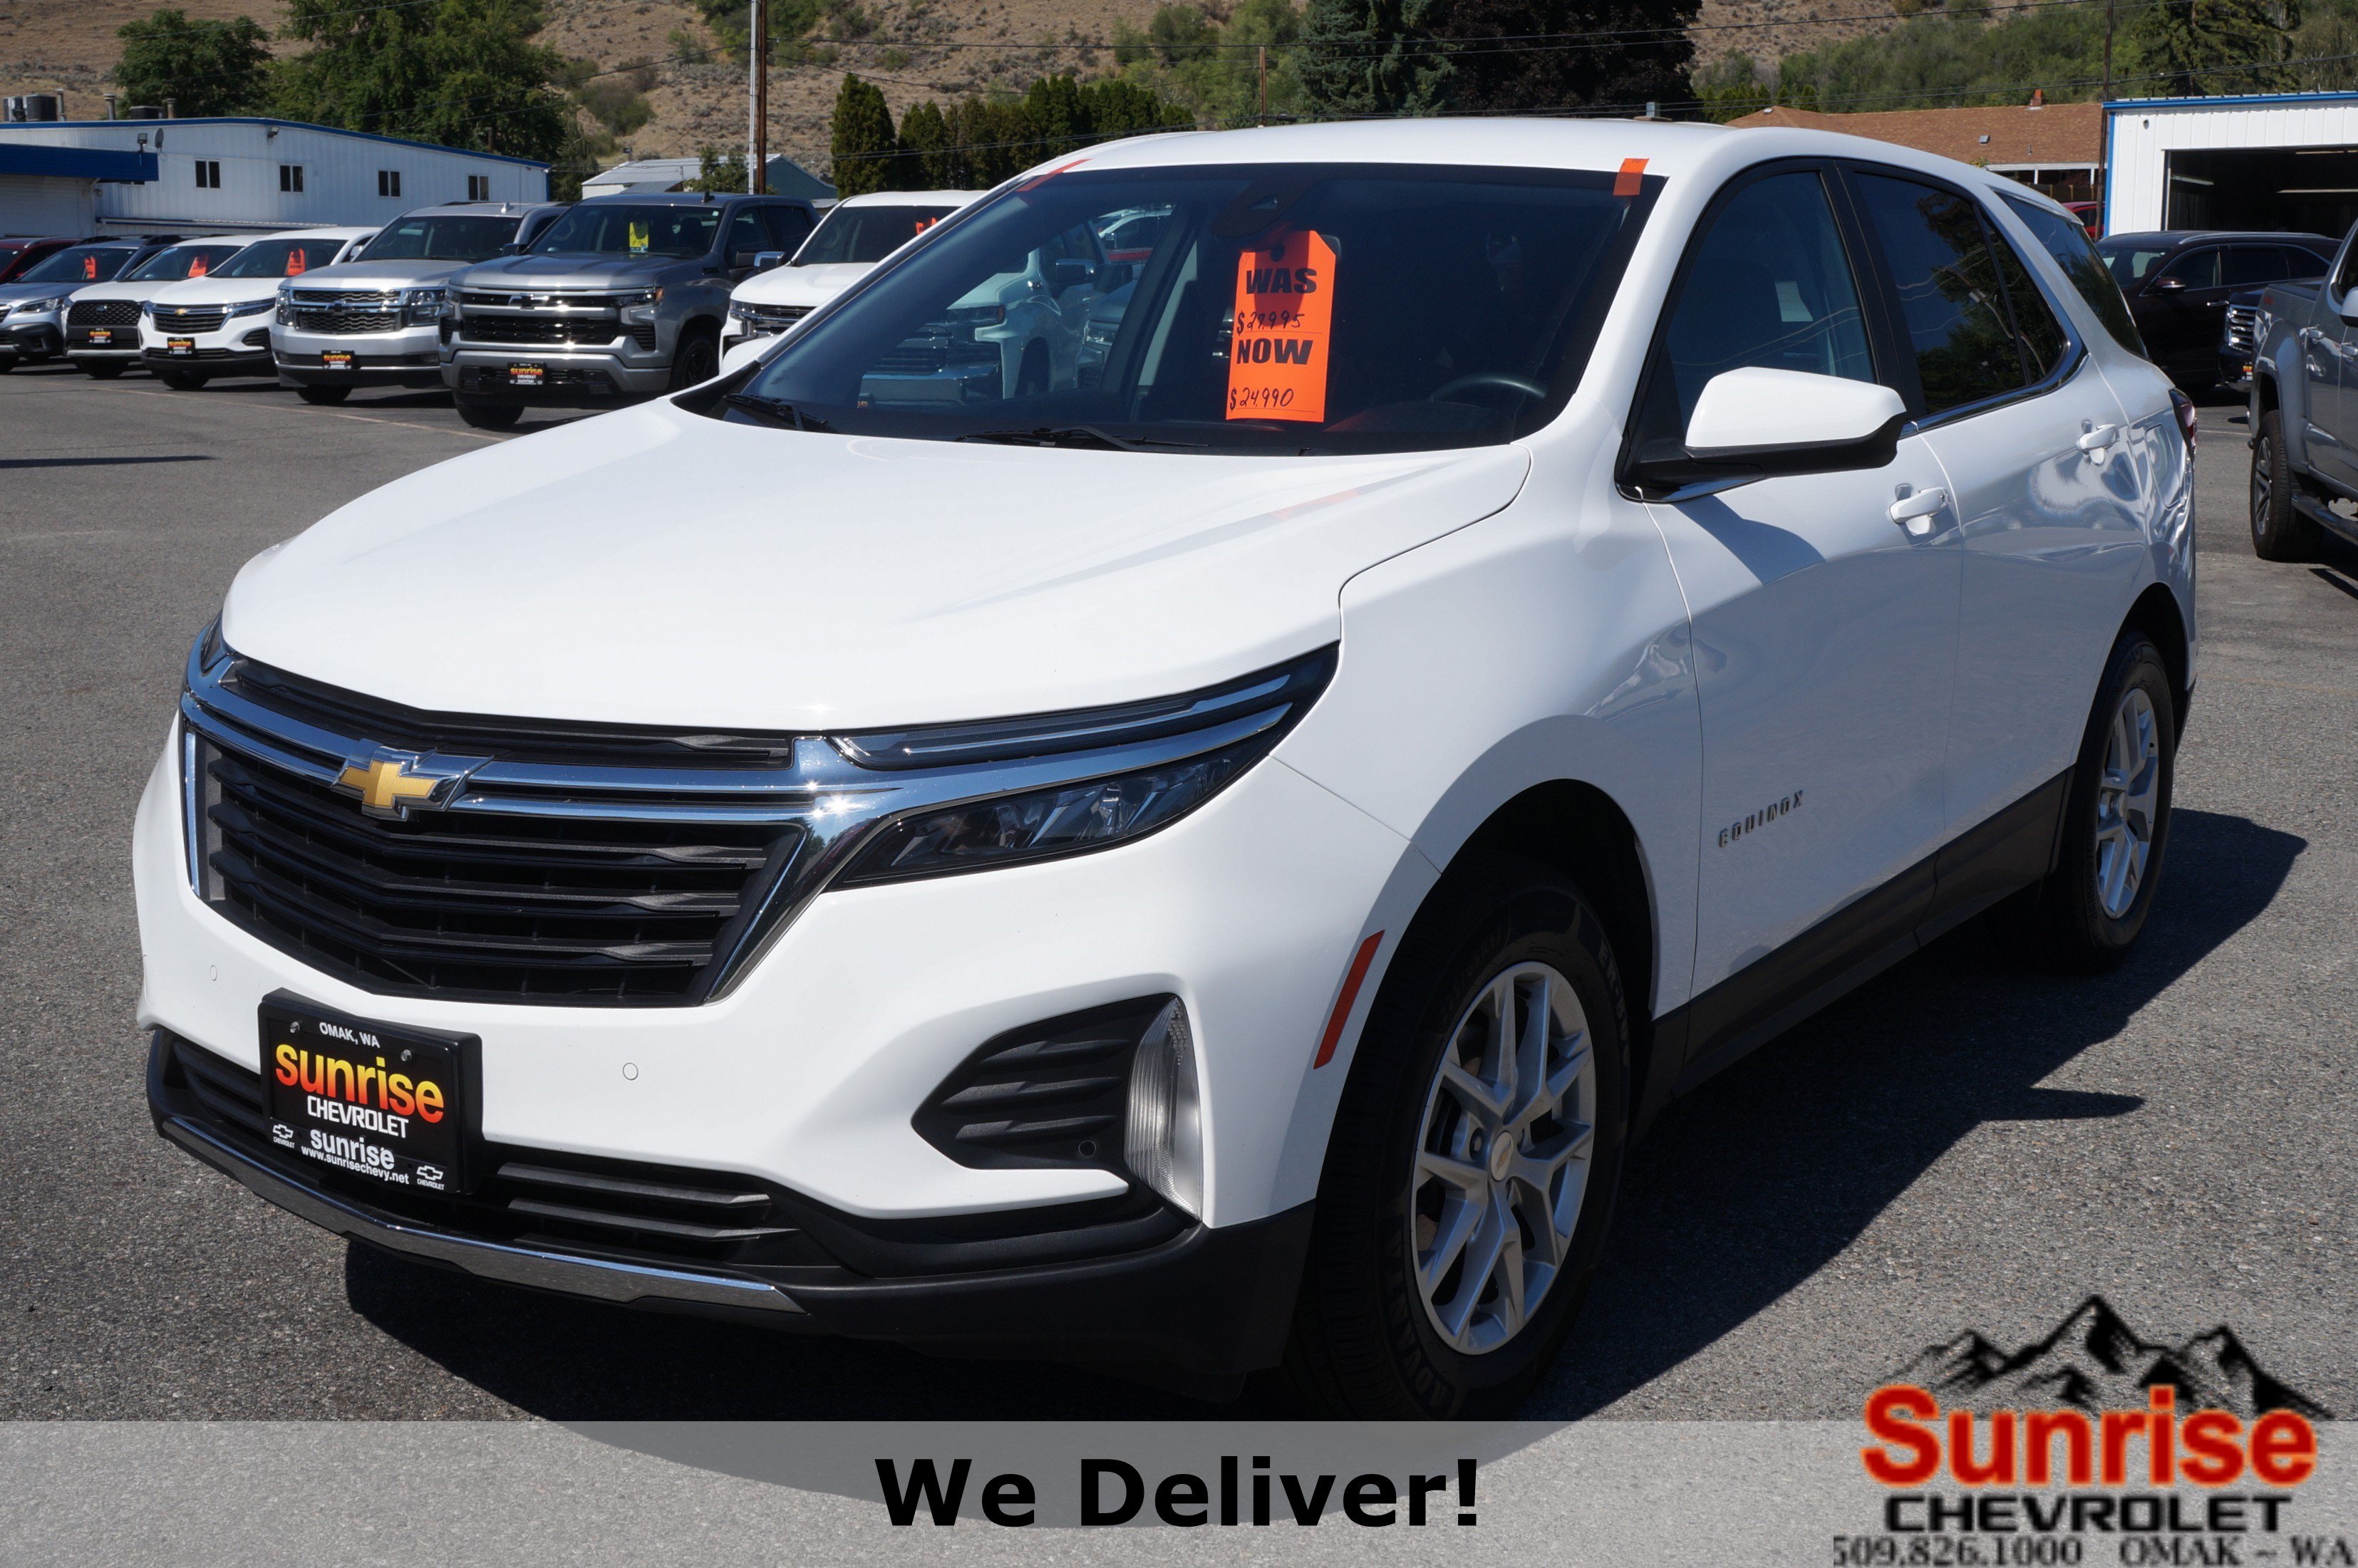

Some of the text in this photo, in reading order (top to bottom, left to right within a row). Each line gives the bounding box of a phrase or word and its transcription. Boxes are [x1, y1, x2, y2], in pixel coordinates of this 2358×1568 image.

[1246, 267, 1318, 295] WAS
[1236, 338, 1313, 365] NOW
[510, 367, 543, 375] sunrise
[1719, 789, 1804, 848] EQUINOX
[319, 1022, 381, 1049] OMAK, WA
[276, 1044, 444, 1123] sunrise
[307, 1095, 409, 1138] CHEVROLET
[273, 1136, 295, 1148] CHEVROLET
[310, 1129, 395, 1170] sunrise
[301, 1146, 409, 1185] www.sunrisechevy.net
[417, 1178, 445, 1190] CHEVROLET
